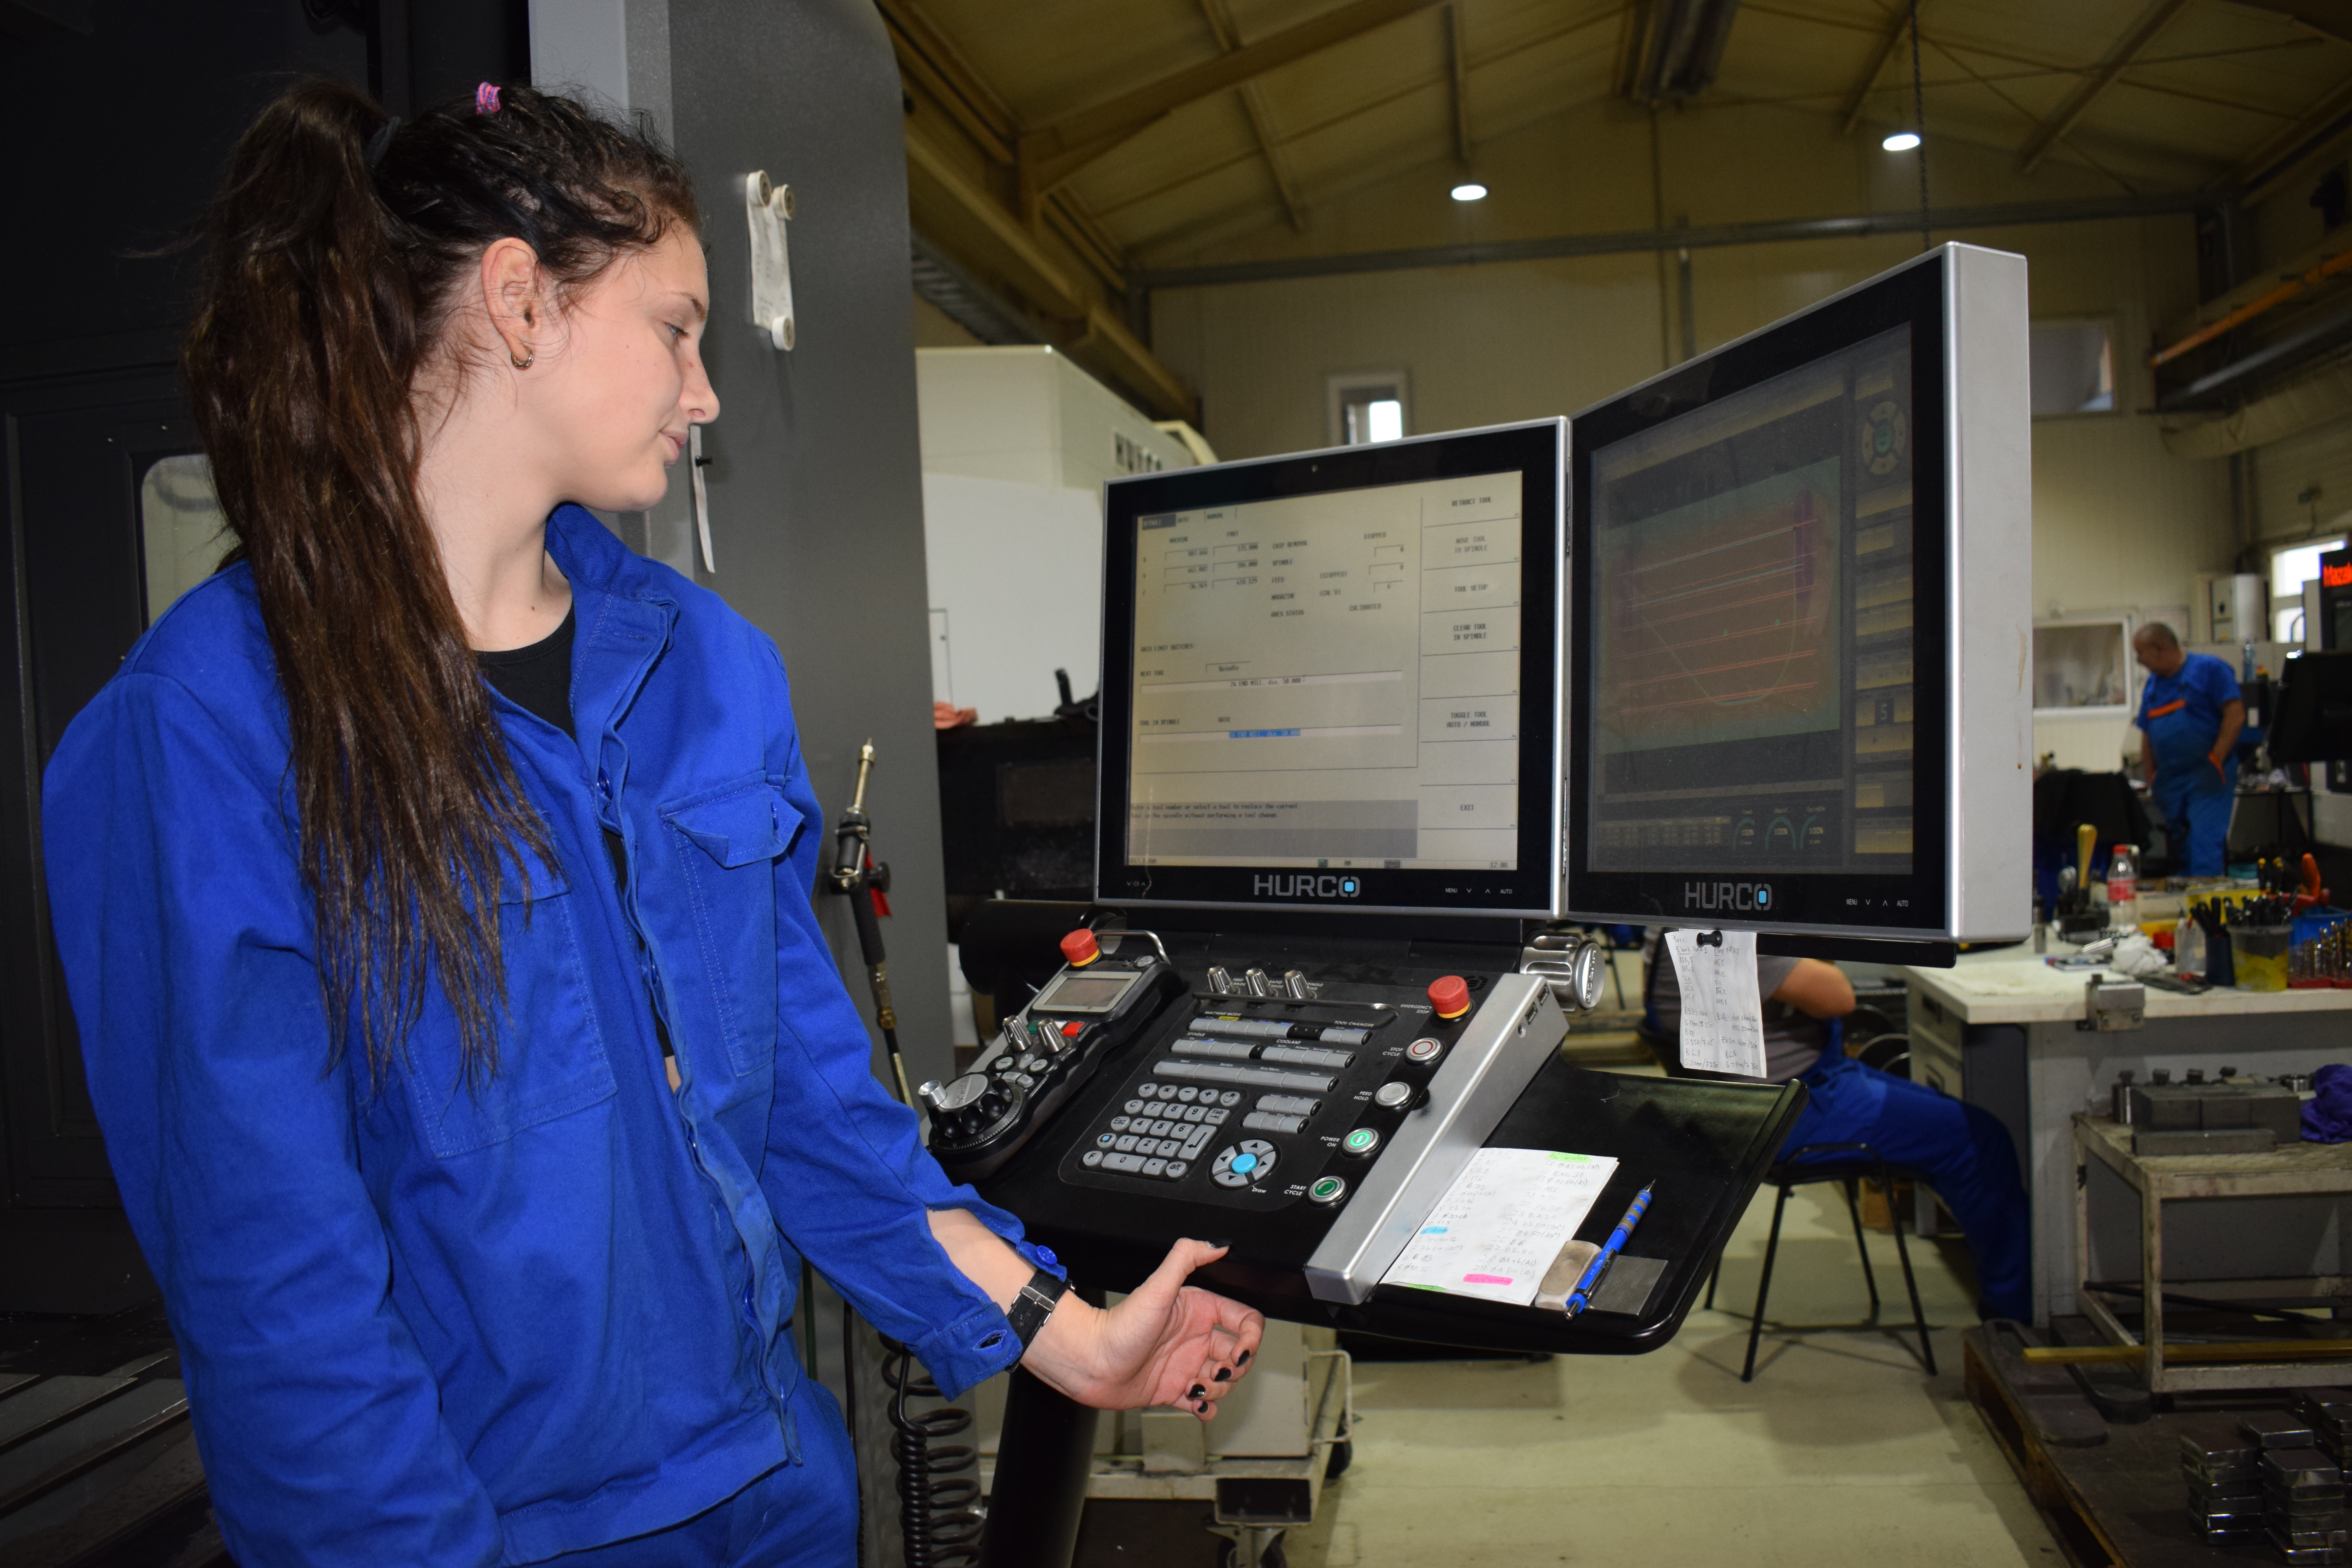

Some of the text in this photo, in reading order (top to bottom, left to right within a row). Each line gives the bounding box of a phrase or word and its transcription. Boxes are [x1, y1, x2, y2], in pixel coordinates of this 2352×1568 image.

[1452, 498, 1475, 506] RETRACT
[1464, 544, 1487, 553] SPINDLE
[1320, 570, 1347, 579] (STOPPED)
[1349, 603, 1382, 611] CALIBRATED
[1463, 632, 1487, 641] SPINDLE
[1809, 826, 1824, 835] 100%
[1254, 874, 1361, 898] HURCO
[1684, 882, 1772, 911] HURCO
[1477, 1254, 1496, 1263] 28
